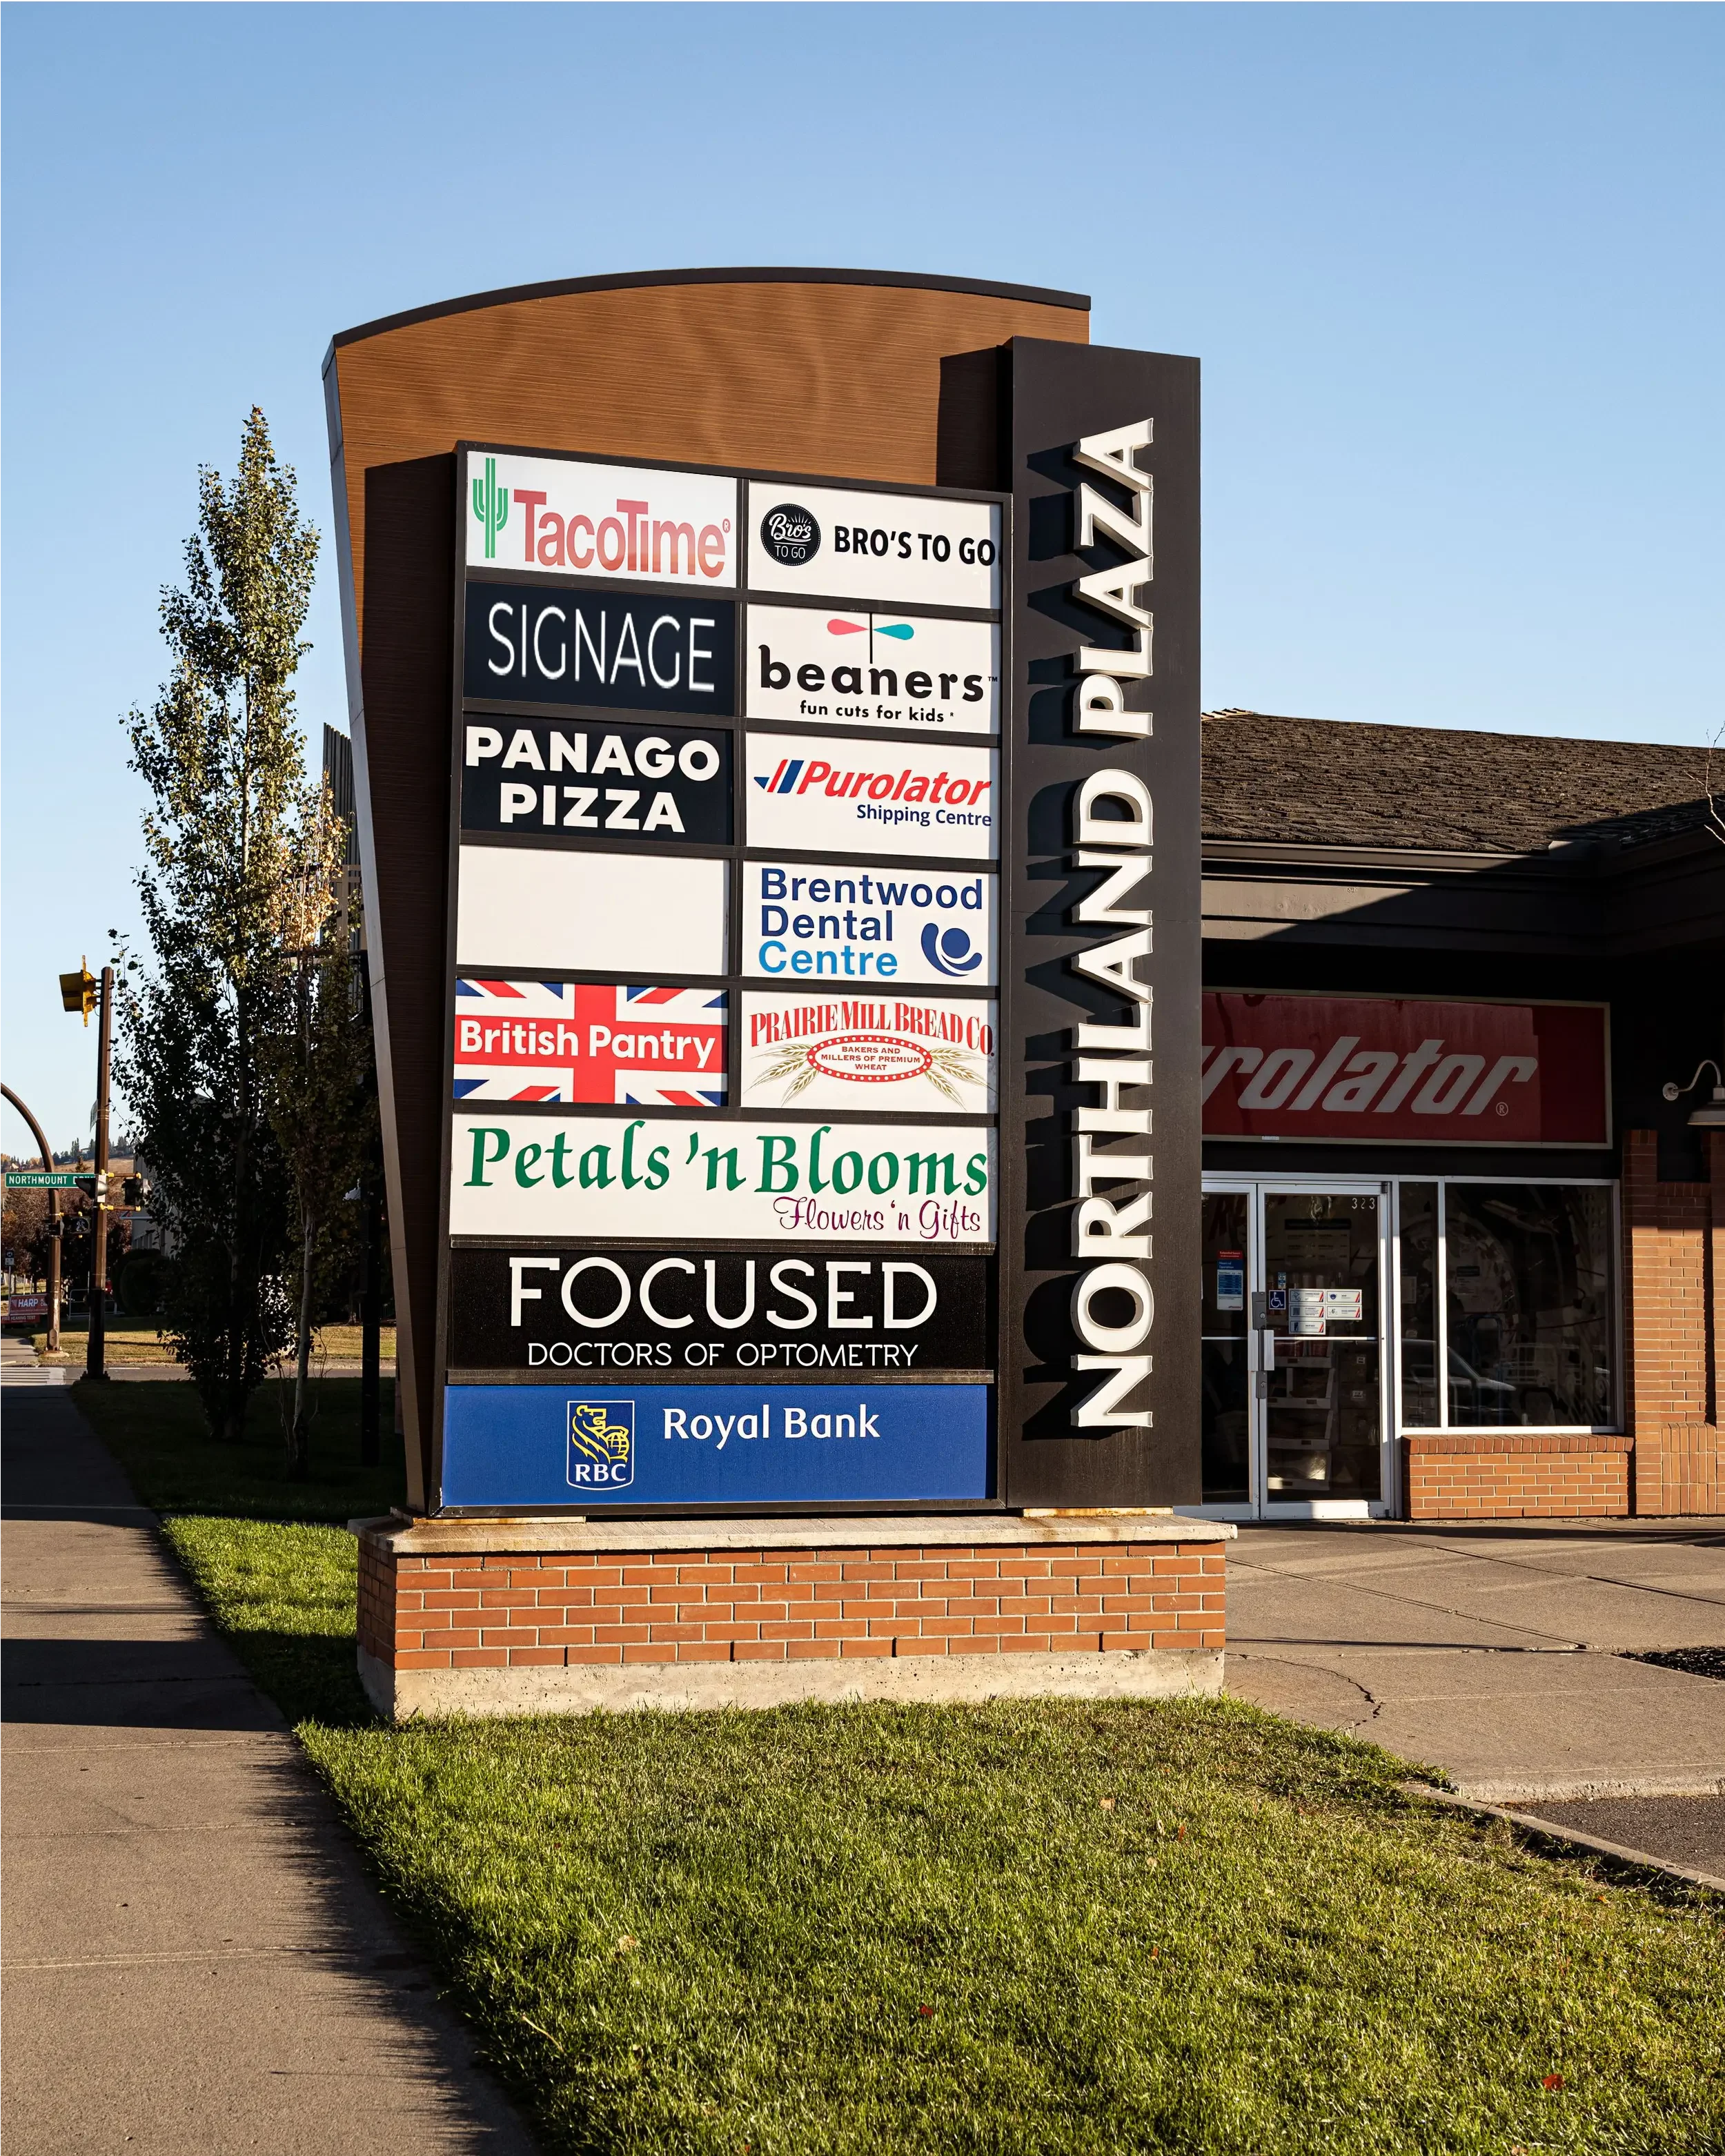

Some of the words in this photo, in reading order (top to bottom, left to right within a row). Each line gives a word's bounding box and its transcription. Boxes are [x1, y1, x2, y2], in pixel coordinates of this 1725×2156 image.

[769, 513, 811, 542] Bro's
[834, 525, 912, 560] BRO'S
[918, 533, 952, 562] TO
[958, 537, 996, 566] GO
[774, 545, 789, 557] TO
[791, 546, 806, 559] GO
[1074, 417, 1154, 737] PLAZA
[487, 601, 716, 693] SIGNAGE
[758, 644, 984, 702] beaners
[800, 700, 828, 715] fun
[836, 705, 869, 718] cuts
[876, 704, 902, 720] for
[909, 706, 945, 722] kids
[465, 726, 720, 782] PANAGO
[796, 760, 993, 806] Purolator
[500, 782, 686, 833] PIZZA
[856, 804, 931, 827] Shipping
[935, 809, 992, 827] Centre
[761, 868, 983, 910] Brentwood
[761, 904, 893, 941] Dental
[758, 940, 898, 977] Centre
[460, 1020, 579, 1056] British
[589, 1025, 716, 1069] Pantry
[750, 1004, 838, 1047] PRAIRIE
[841, 1000, 891, 1030] MILL
[894, 1002, 963, 1044] BREAD
[1074, 769, 1154, 1427] NORTHLAND
[463, 1120, 670, 1190] Petals
[686, 1131, 747, 1192] 'n
[754, 1126, 987, 1196] Blooms
[9, 1176, 68, 1185] NORTHMOUNT
[773, 1196, 885, 1230] Flowers
[919, 1200, 980, 1240] Gifts
[1352, 1198, 1375, 1209] 323
[18, 1298, 39, 1307] HARP
[509, 1257, 938, 1329] FOCUSED
[528, 1342, 672, 1367] DOCTORS
[684, 1343, 724, 1367] OF
[736, 1343, 919, 1367] OPTOMETRY
[662, 1404, 769, 1450] Royal
[783, 1404, 880, 1438] Bank
[575, 1463, 627, 1483] RBC
